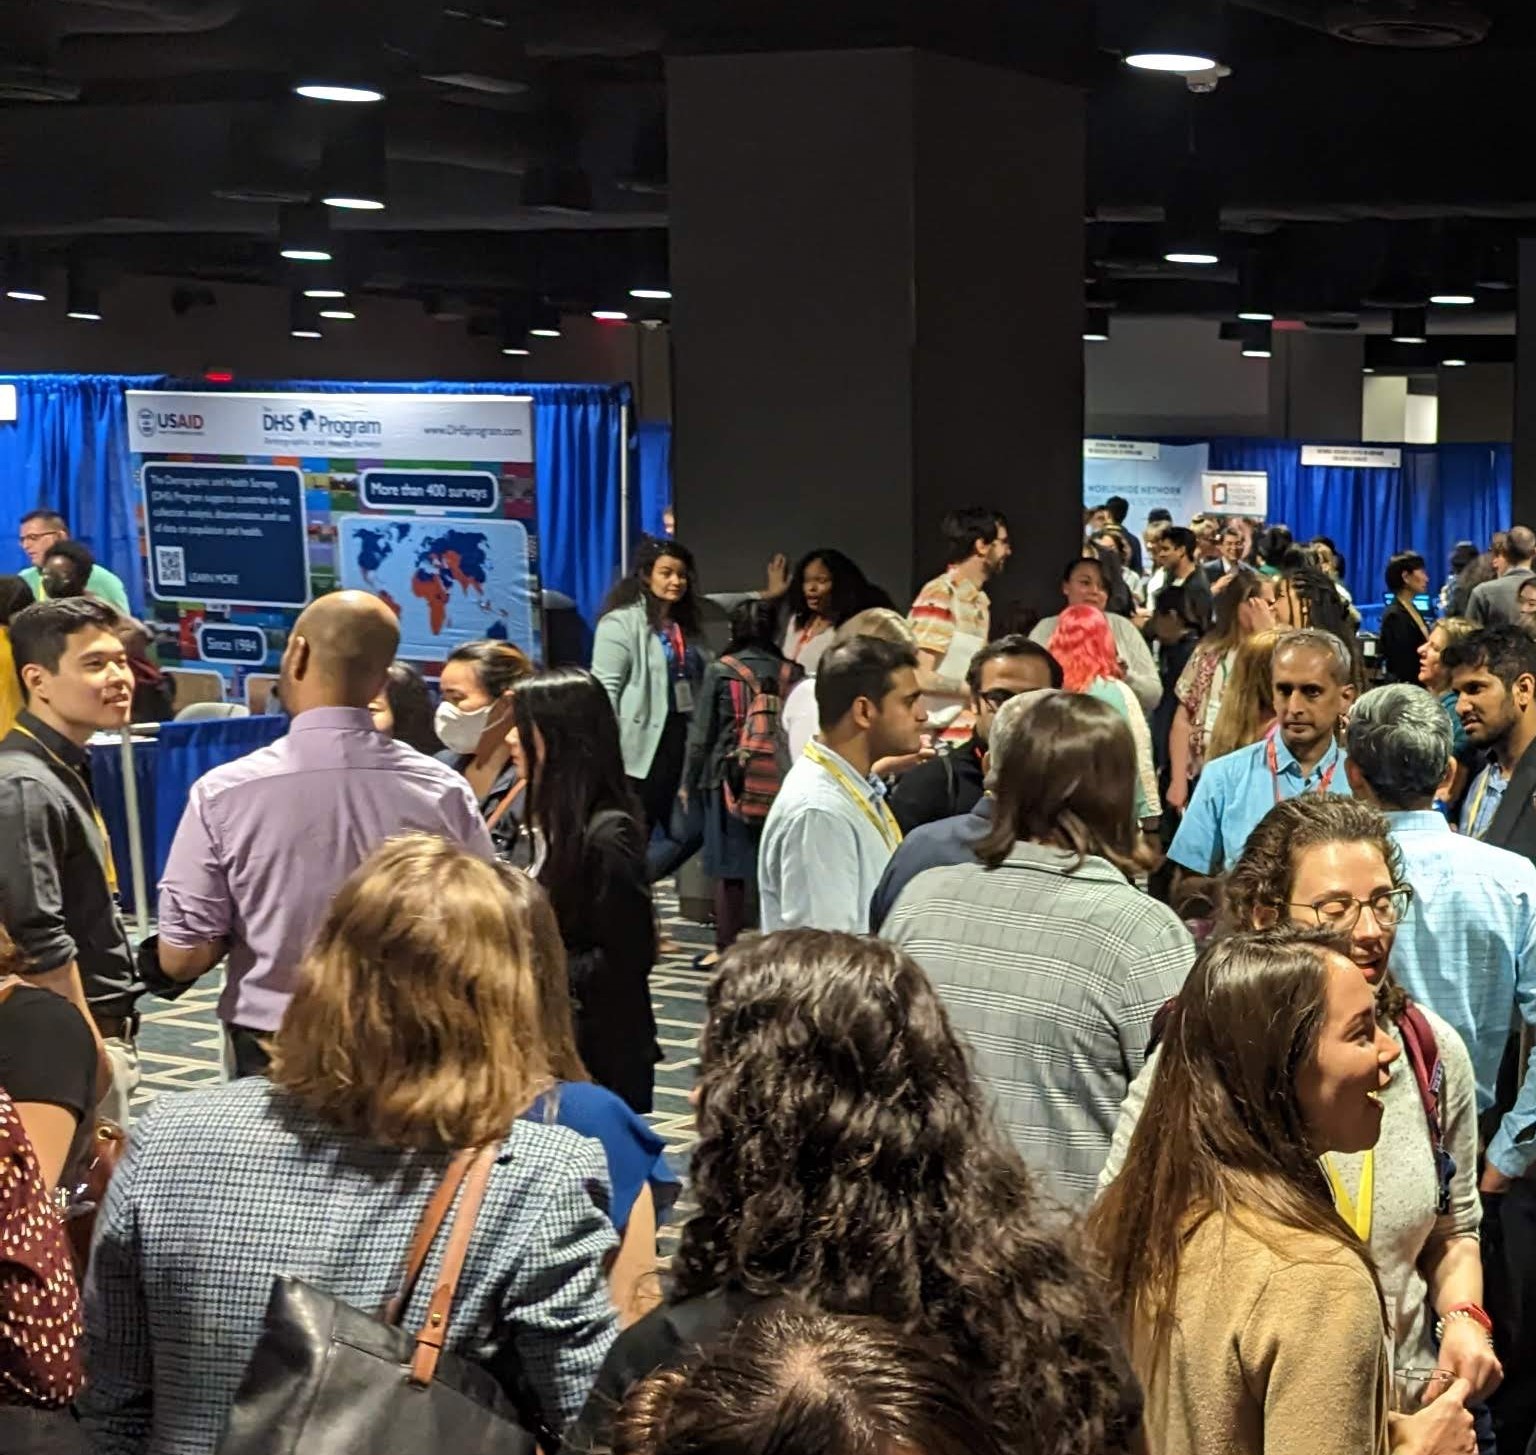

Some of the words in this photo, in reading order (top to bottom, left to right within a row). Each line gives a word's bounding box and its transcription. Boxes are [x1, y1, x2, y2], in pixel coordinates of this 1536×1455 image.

[158, 413, 204, 430] USAID
[263, 414, 295, 432] DHS
[319, 415, 382, 438] Program
[370, 482, 399, 496] More
[401, 483, 424, 497] than
[426, 484, 446, 498] 400
[448, 488, 488, 502] surveys
[1088, 485, 1139, 494] WORLDWIDE
[1140, 486, 1181, 494] NETWORK
[215, 574, 239, 584] MORE
[207, 636, 232, 650] Since
